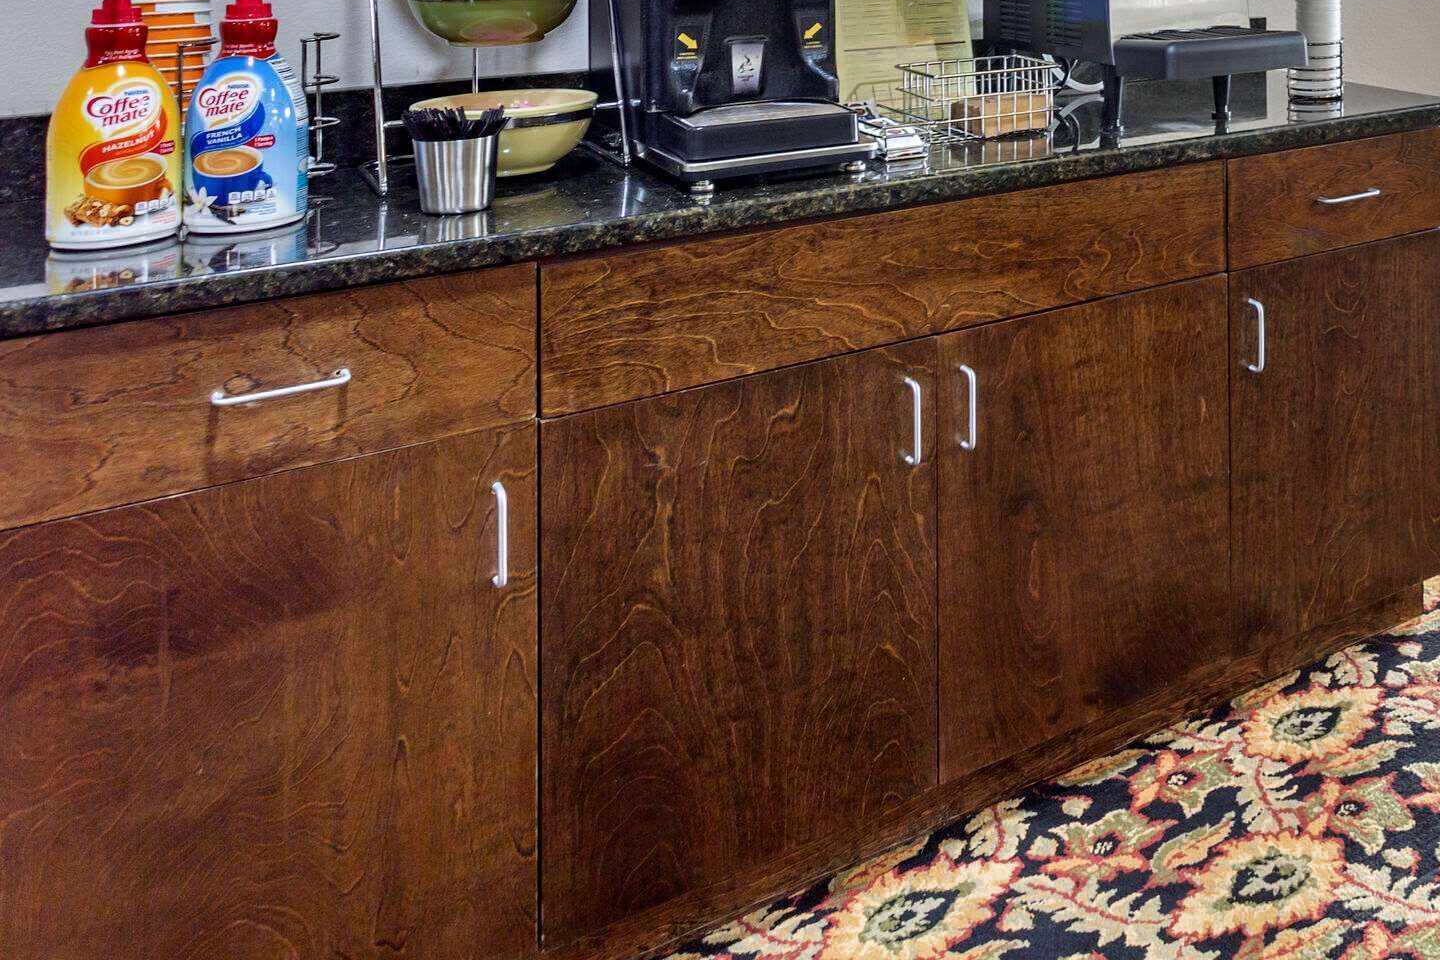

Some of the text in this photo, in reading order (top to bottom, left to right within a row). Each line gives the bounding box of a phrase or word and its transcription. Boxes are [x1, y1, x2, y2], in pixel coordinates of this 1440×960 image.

[86, 95, 150, 118] Coffee
[199, 88, 249, 109] Coffee
[102, 107, 148, 127] mate
[206, 101, 245, 118] mate
[102, 129, 156, 154] HAZELNUT
[206, 126, 242, 139] FRENCH
[207, 133, 242, 145] VANILLA
